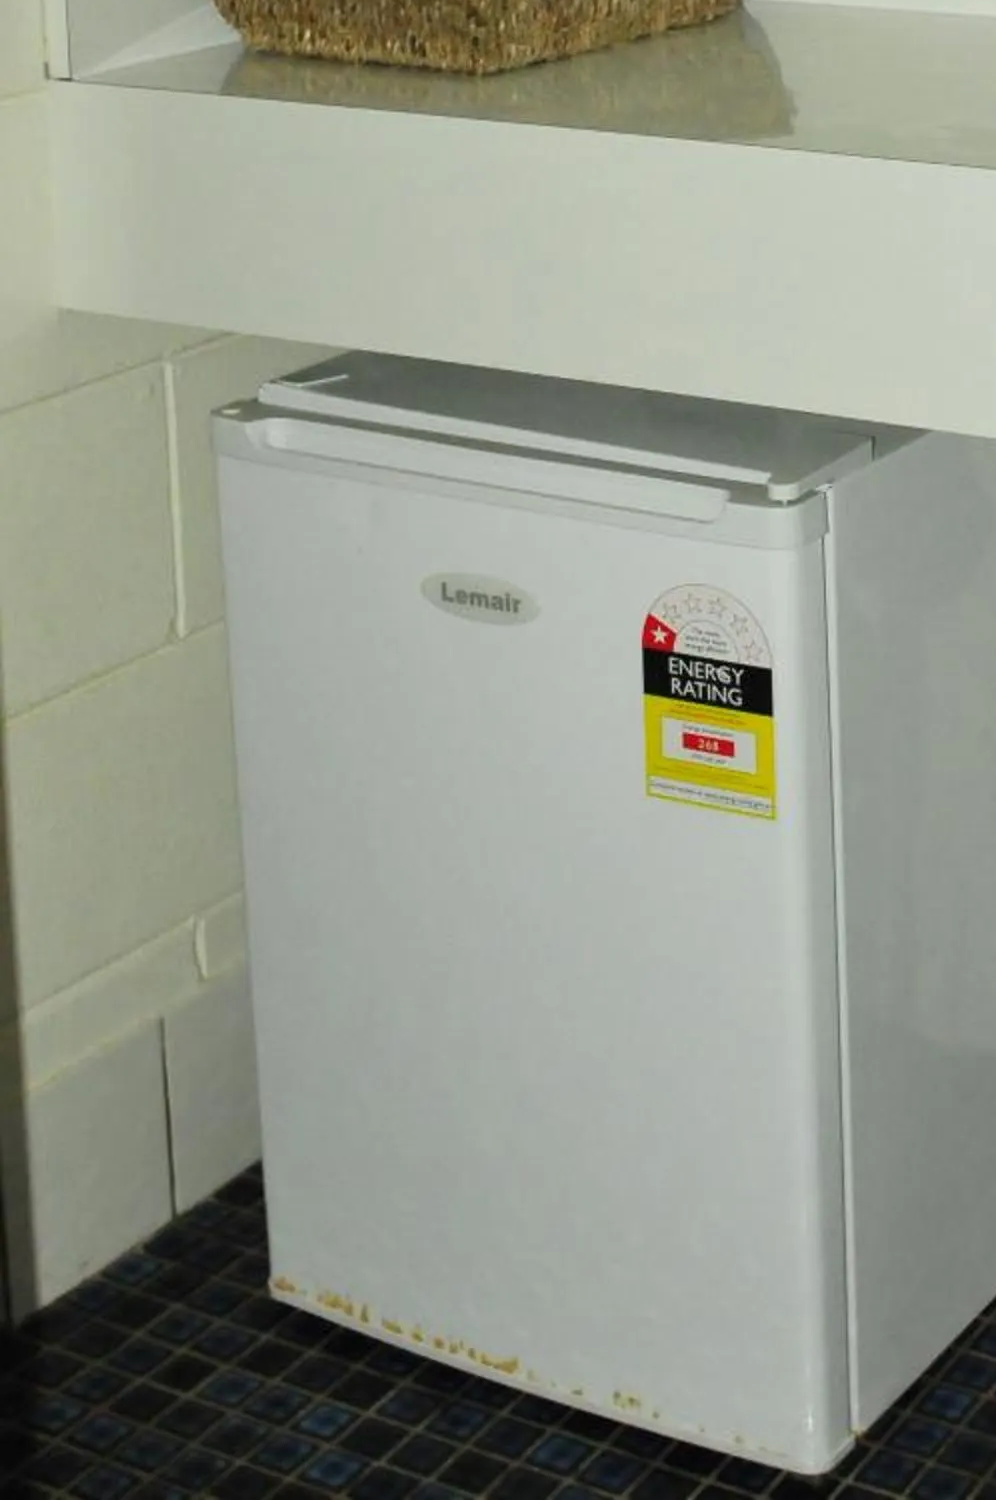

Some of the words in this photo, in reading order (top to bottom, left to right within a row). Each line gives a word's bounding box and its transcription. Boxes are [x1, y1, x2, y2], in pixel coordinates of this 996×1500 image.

[441, 581, 521, 613] Lemair
[668, 657, 744, 686] ENERGY
[671, 677, 743, 707] RATING
